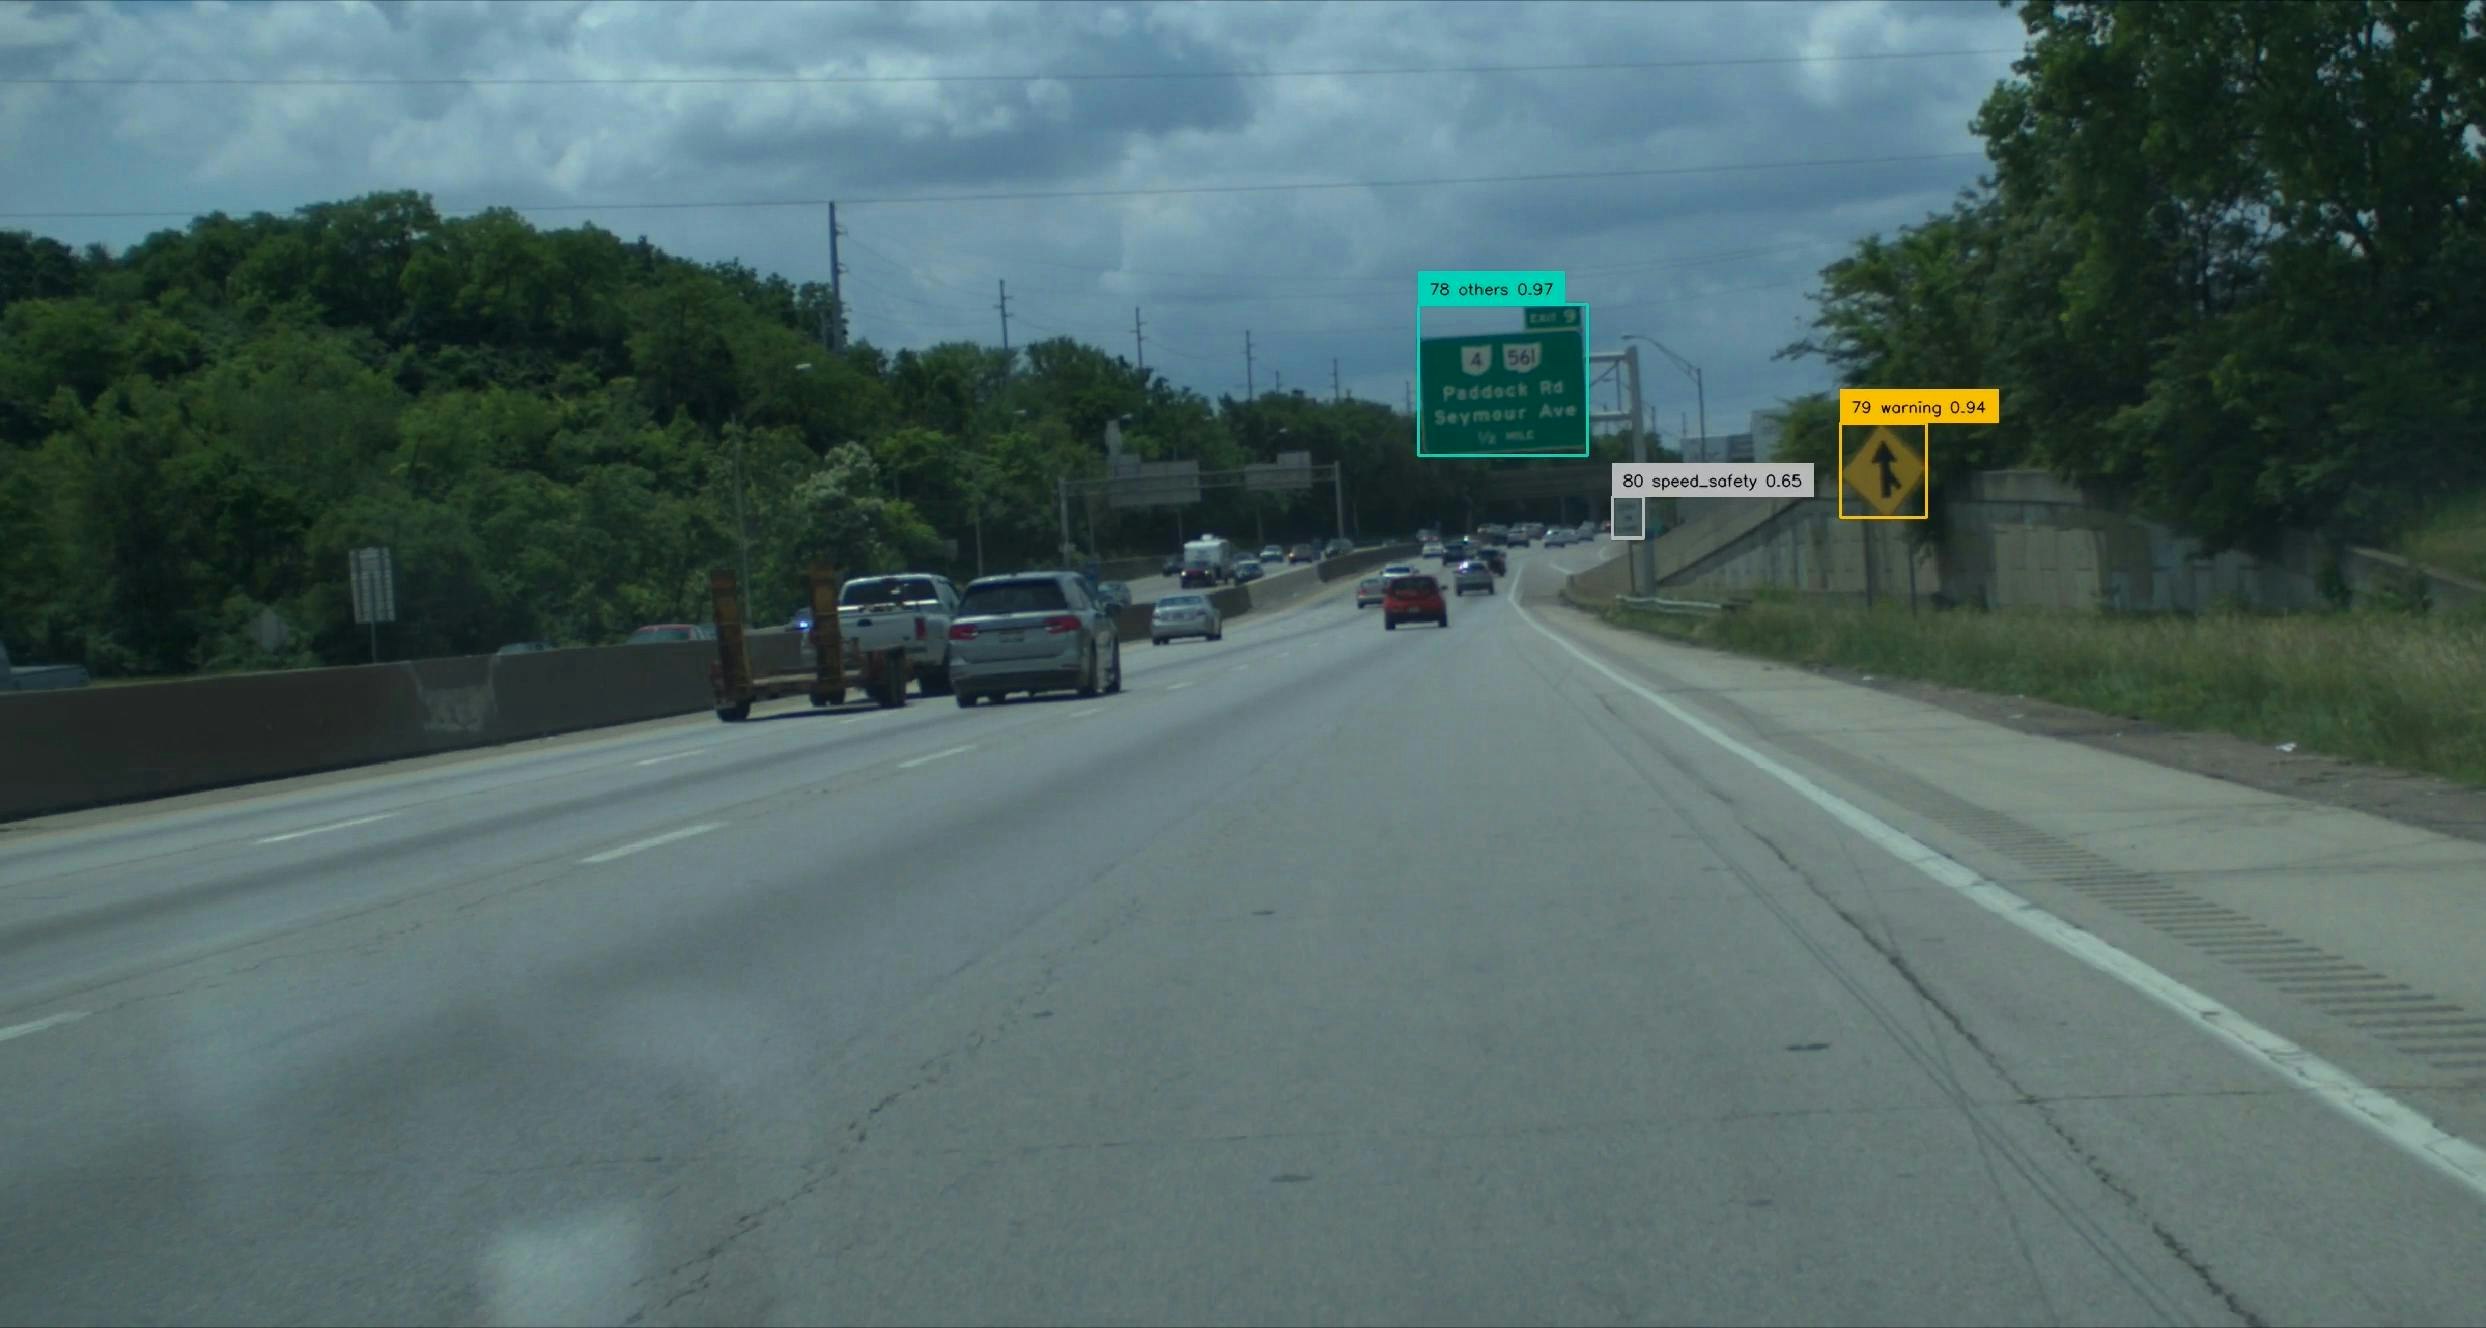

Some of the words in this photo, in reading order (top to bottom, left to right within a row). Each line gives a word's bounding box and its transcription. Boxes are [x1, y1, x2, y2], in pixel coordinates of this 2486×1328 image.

[1470, 352, 1482, 367] 4
[1507, 349, 1536, 366] 561
[1442, 381, 1529, 402] Paddock
[1539, 380, 1564, 395] Rd
[1434, 407, 1527, 426] Seymour
[1539, 403, 1577, 418] Ave
[1505, 430, 1535, 441] MILE
